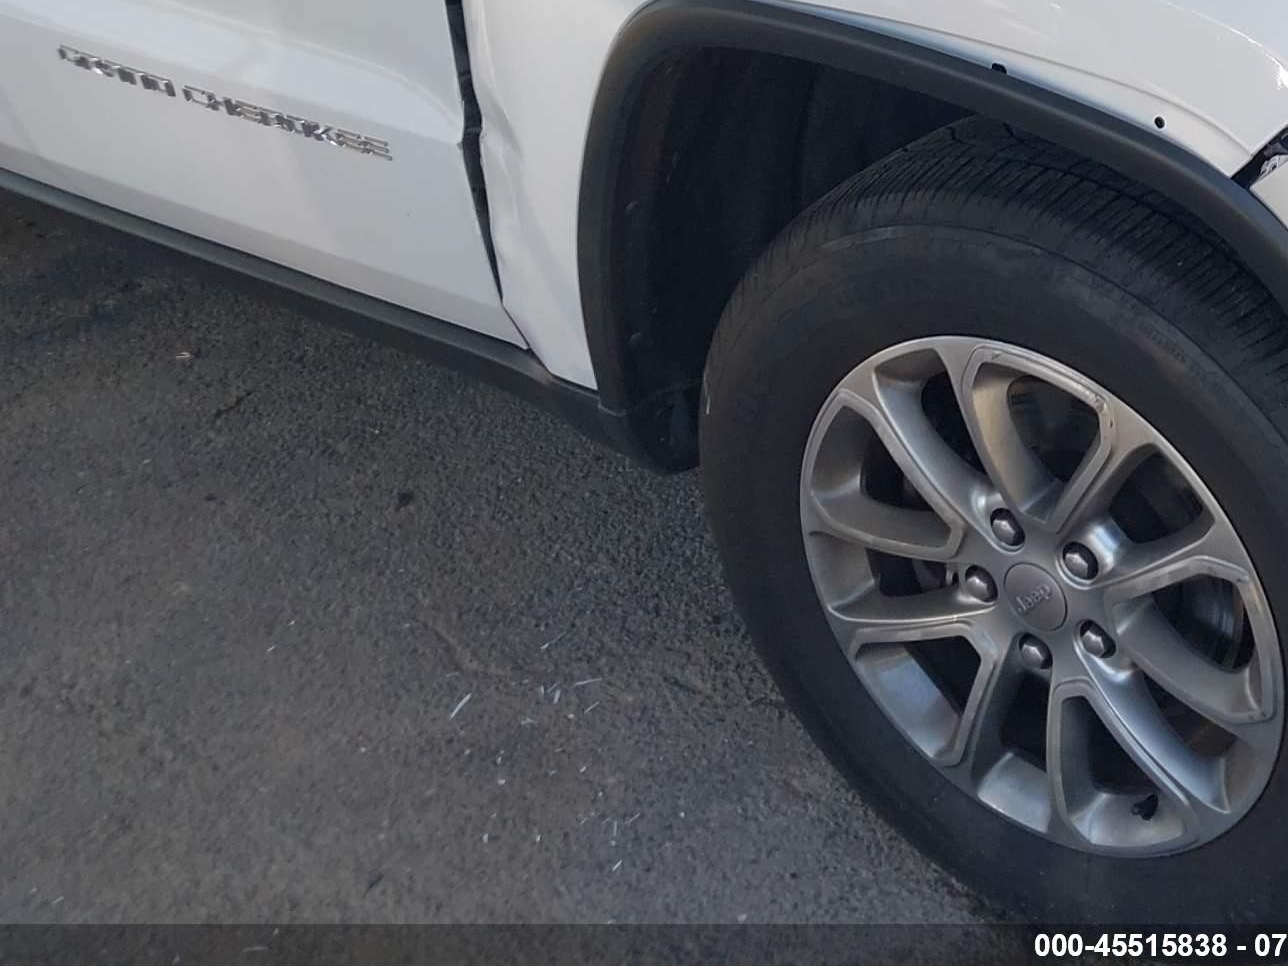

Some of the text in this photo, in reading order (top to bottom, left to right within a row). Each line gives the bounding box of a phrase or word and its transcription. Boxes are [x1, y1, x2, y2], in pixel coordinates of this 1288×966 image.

[57, 43, 393, 161] GRAND CHEROKEE
[1015, 584, 1051, 613] Jeep
